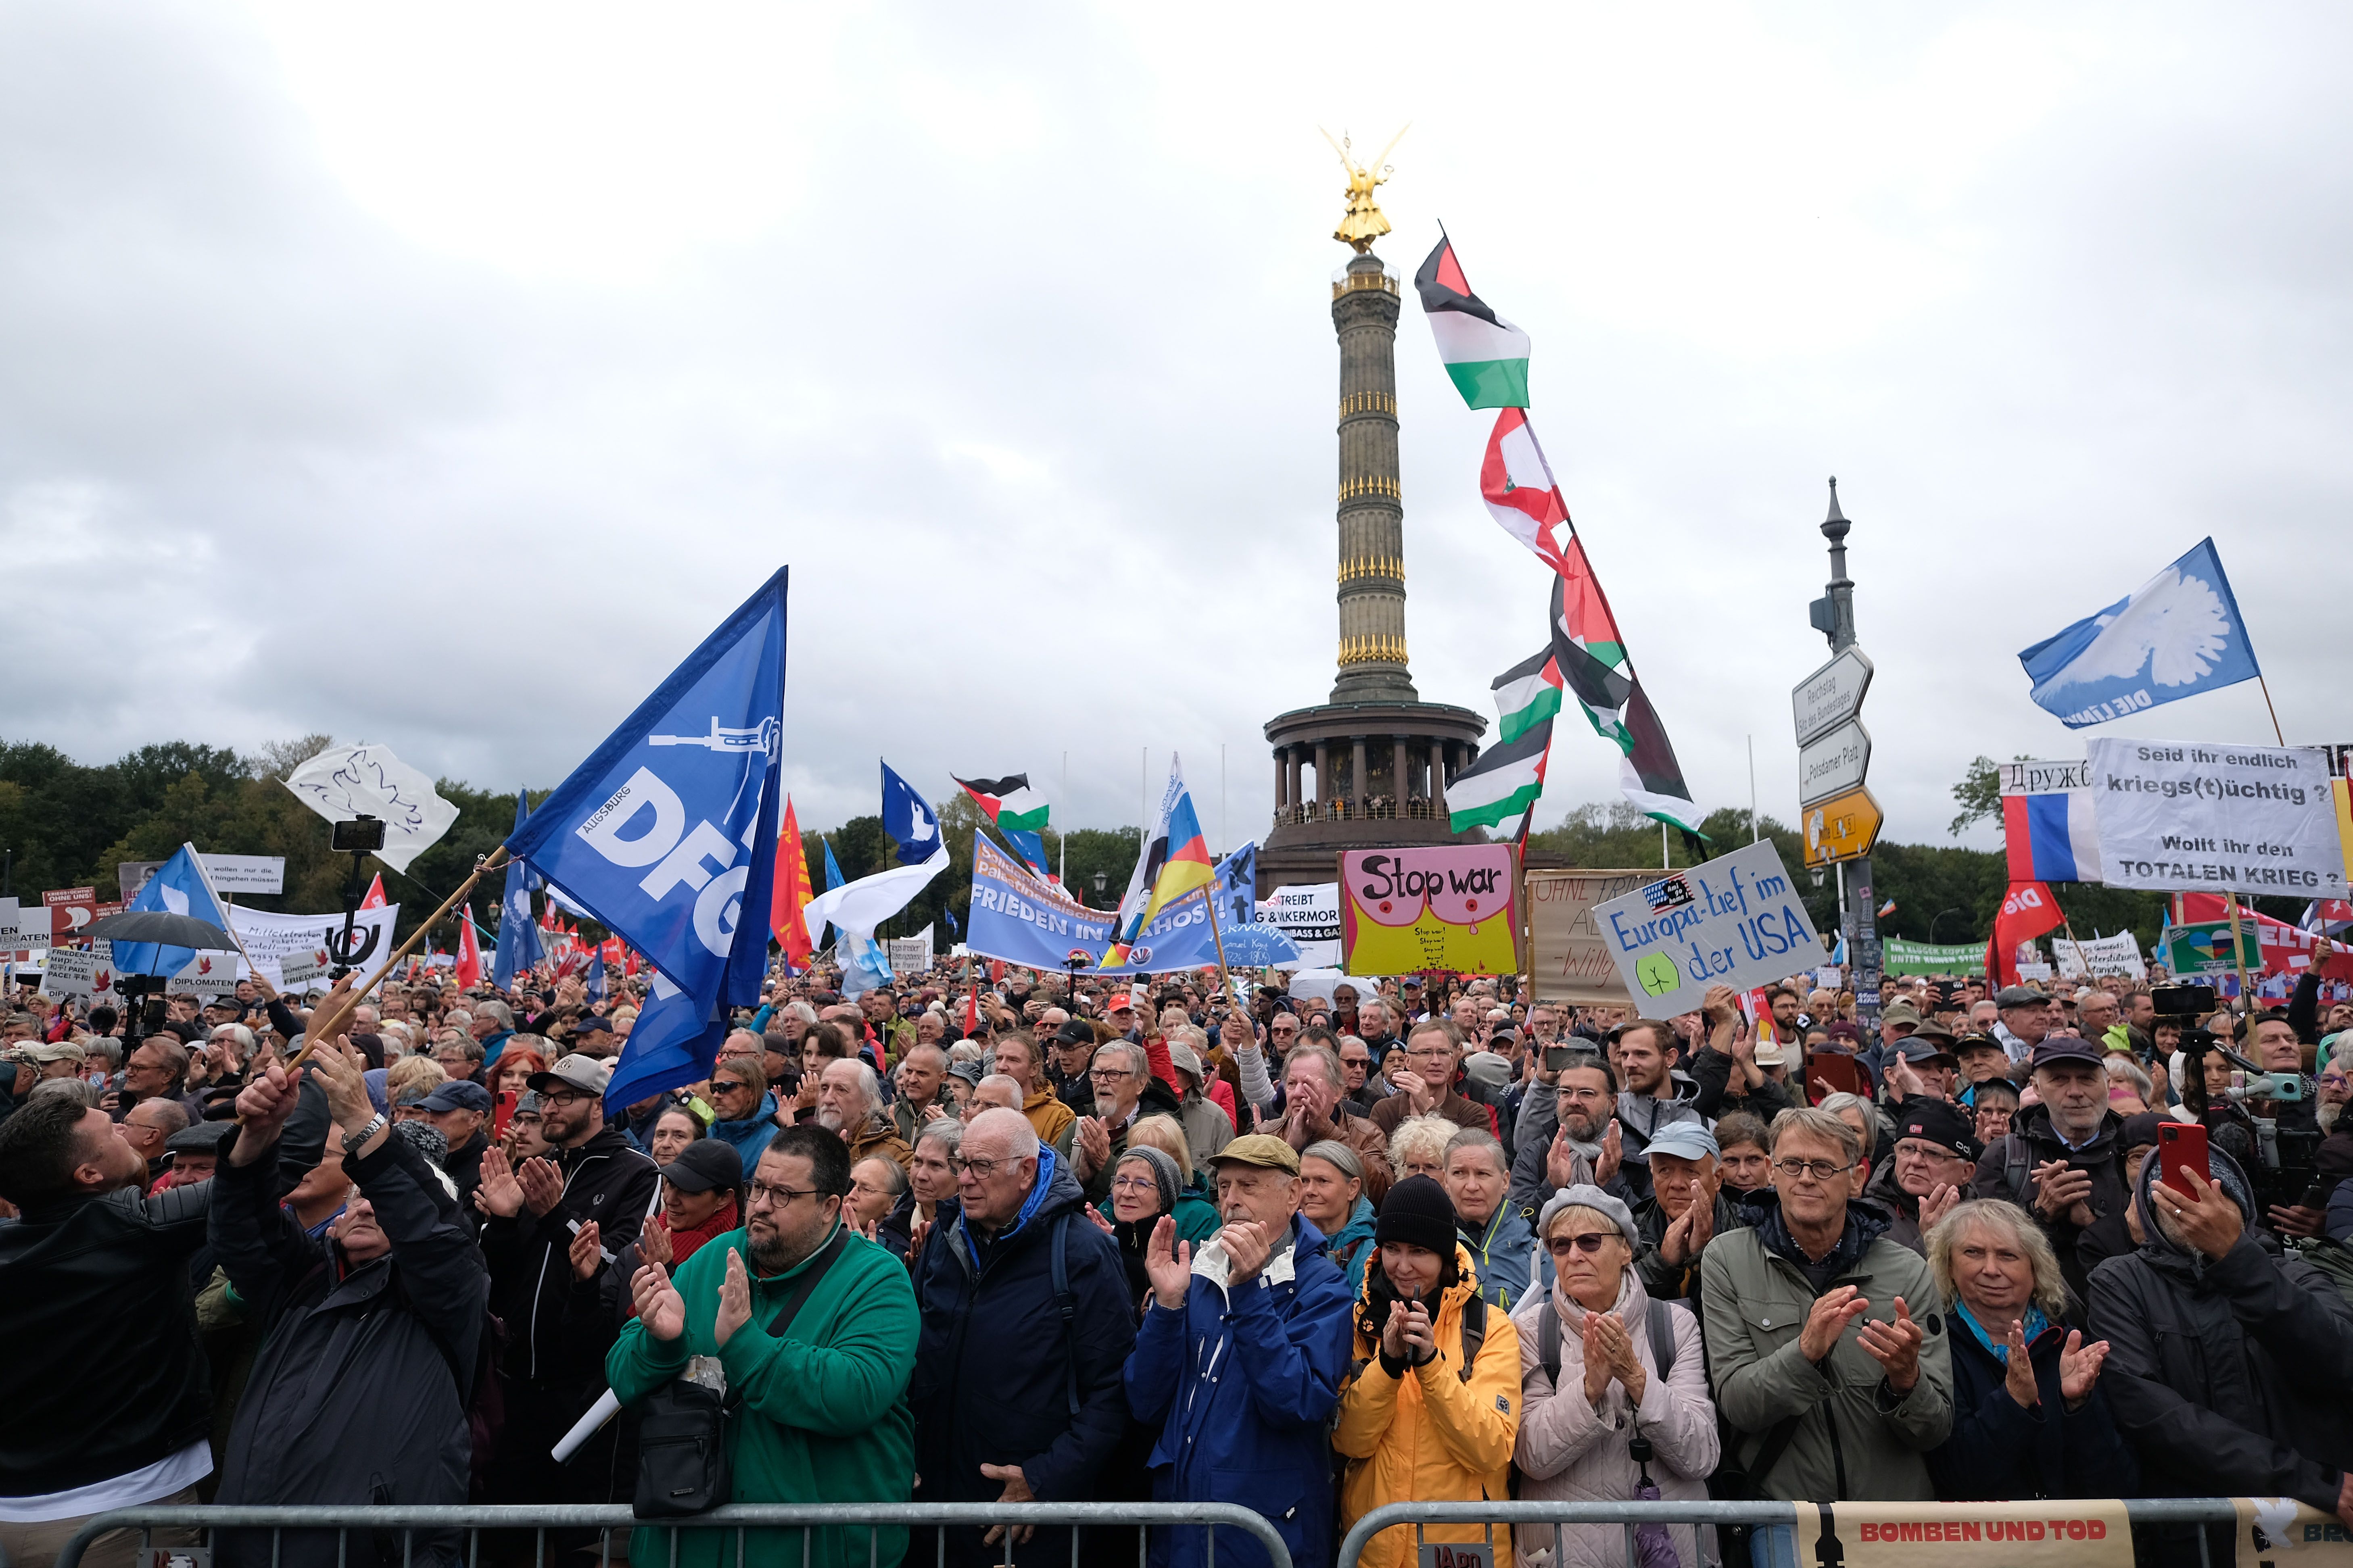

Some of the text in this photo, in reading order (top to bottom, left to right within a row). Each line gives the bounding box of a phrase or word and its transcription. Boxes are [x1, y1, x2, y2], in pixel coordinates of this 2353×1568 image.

[1807, 677, 1836, 706] Reichstag
[1799, 690, 1850, 733] Sitz des Bundestages
[1810, 745, 1858, 781] Potsdamer Platz
[2138, 746, 2298, 769] Seid ihr endlich
[2009, 759, 2091, 791] Дружб
[2107, 774, 2306, 805] kriegs(t)üchtig
[583, 786, 631, 834] AUGSBURG
[1848, 818, 1851, 831] 5
[2161, 836, 2294, 857] Wollt ihr den
[981, 845, 1056, 899] Solidarität
[1361, 855, 1502, 905] Stop war
[2119, 860, 2237, 881] TOTALEN
[2244, 866, 2318, 886] KRIEG
[978, 861, 1116, 924] Palästinensischen
[1536, 878, 1588, 902] OHNE
[1667, 882, 1679, 892] Ami
[1675, 888, 1683, 897] go
[1751, 872, 1786, 901] im
[970, 883, 1068, 936] FRIEDEN
[1075, 923, 1104, 941] IN
[1669, 895, 1684, 905] home
[1268, 911, 1277, 923] &
[1568, 908, 1600, 935] AL
[1689, 942, 1736, 982] der
[1738, 904, 1811, 961] USA
[282, 963, 313, 974] BÜNDNIS
[284, 970, 326, 985] FRIEDEN!
[175, 978, 233, 986] DIPLOMATEN
[1860, 1520, 2107, 1542] BOMBEN UND TOD
